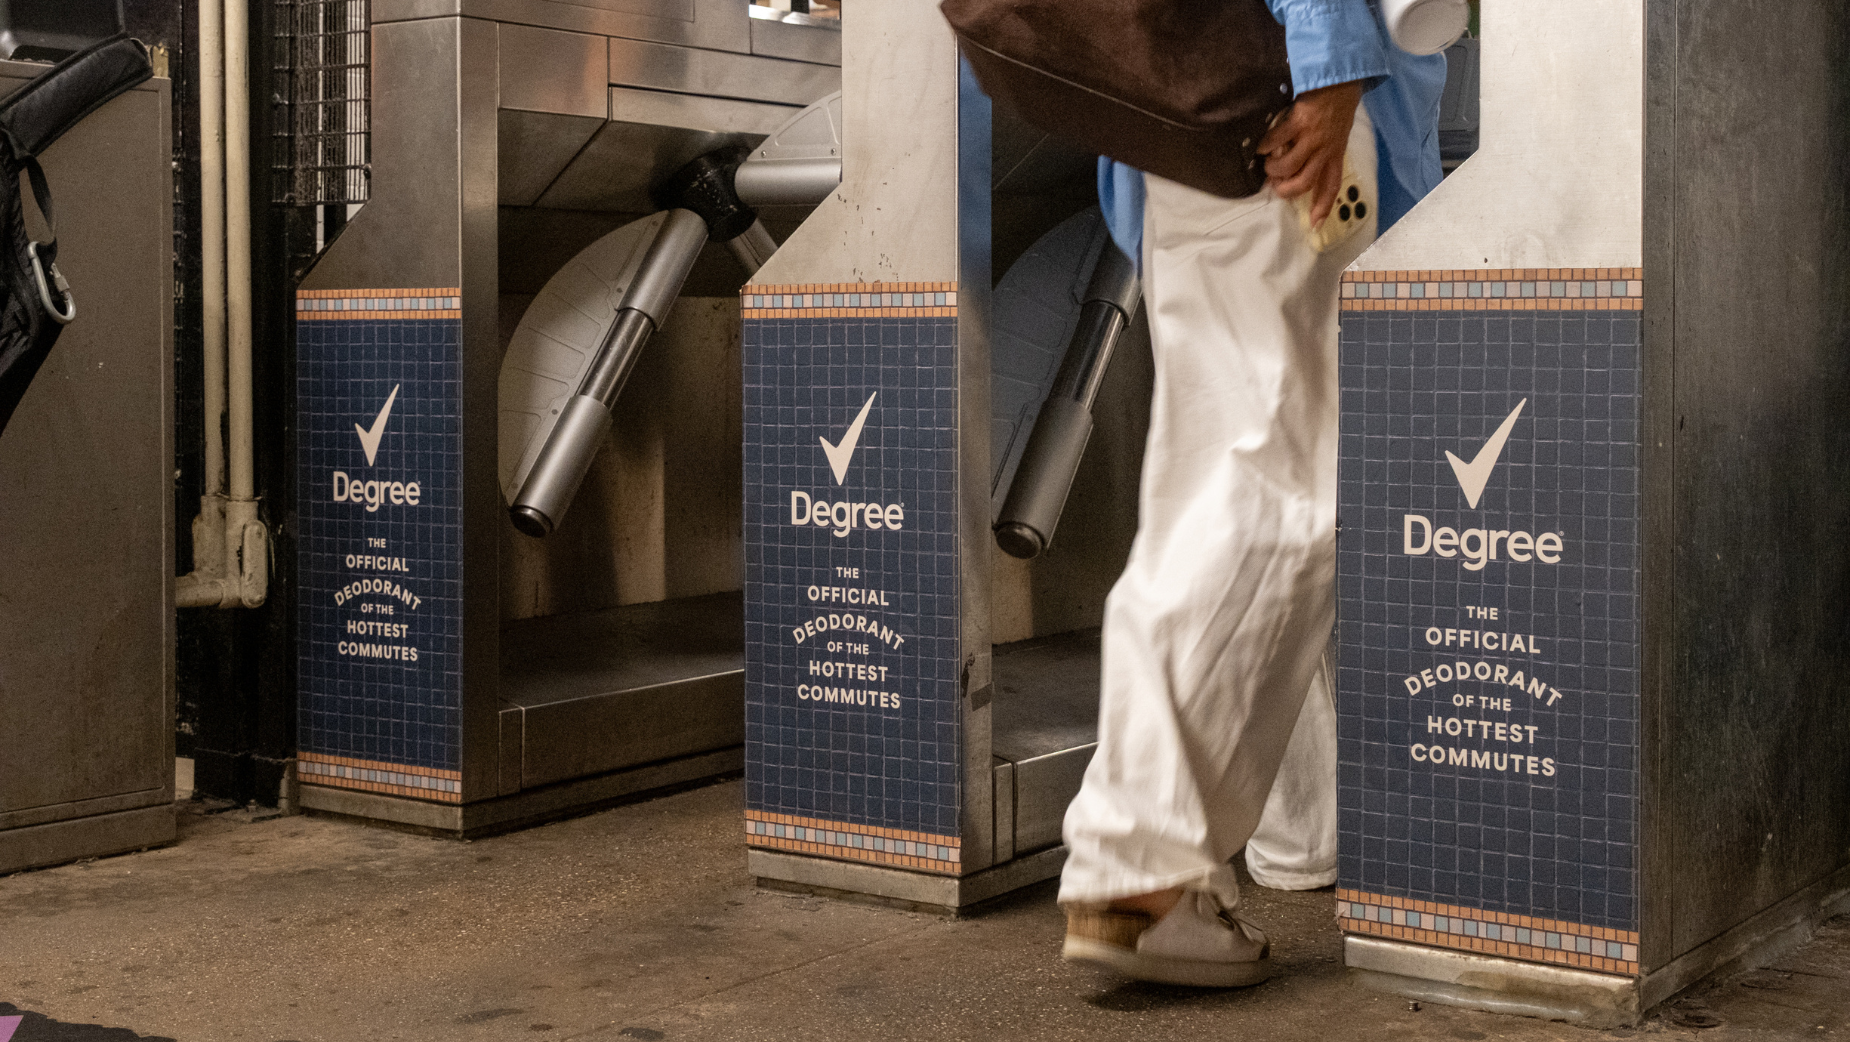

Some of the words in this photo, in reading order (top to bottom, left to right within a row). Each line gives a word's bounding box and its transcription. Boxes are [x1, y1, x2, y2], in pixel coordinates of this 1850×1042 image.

[368, 538, 386, 550] THE
[346, 554, 410, 573] OFFICIAL
[836, 566, 860, 579] THE
[335, 579, 422, 611] DEODORANT
[807, 585, 890, 606] OFFICIAL
[361, 603, 374, 614] OF
[376, 605, 394, 616] THE
[1466, 605, 1499, 621] THE
[347, 621, 409, 639] HOTTEST
[793, 614, 905, 651] DEODORANT
[1425, 627, 1541, 654] OFFICIAL
[338, 642, 419, 663] COMMUTES
[827, 641, 843, 653] OF
[846, 642, 870, 655] THE
[809, 660, 889, 682] HOTTEST
[1404, 661, 1563, 708] DEODORANT
[797, 684, 902, 710] COMMUTES
[1452, 693, 1475, 708] OF
[1480, 695, 1512, 712] THE
[1427, 716, 1539, 744] HOTTEST
[1410, 744, 1556, 777] COMMUTES
